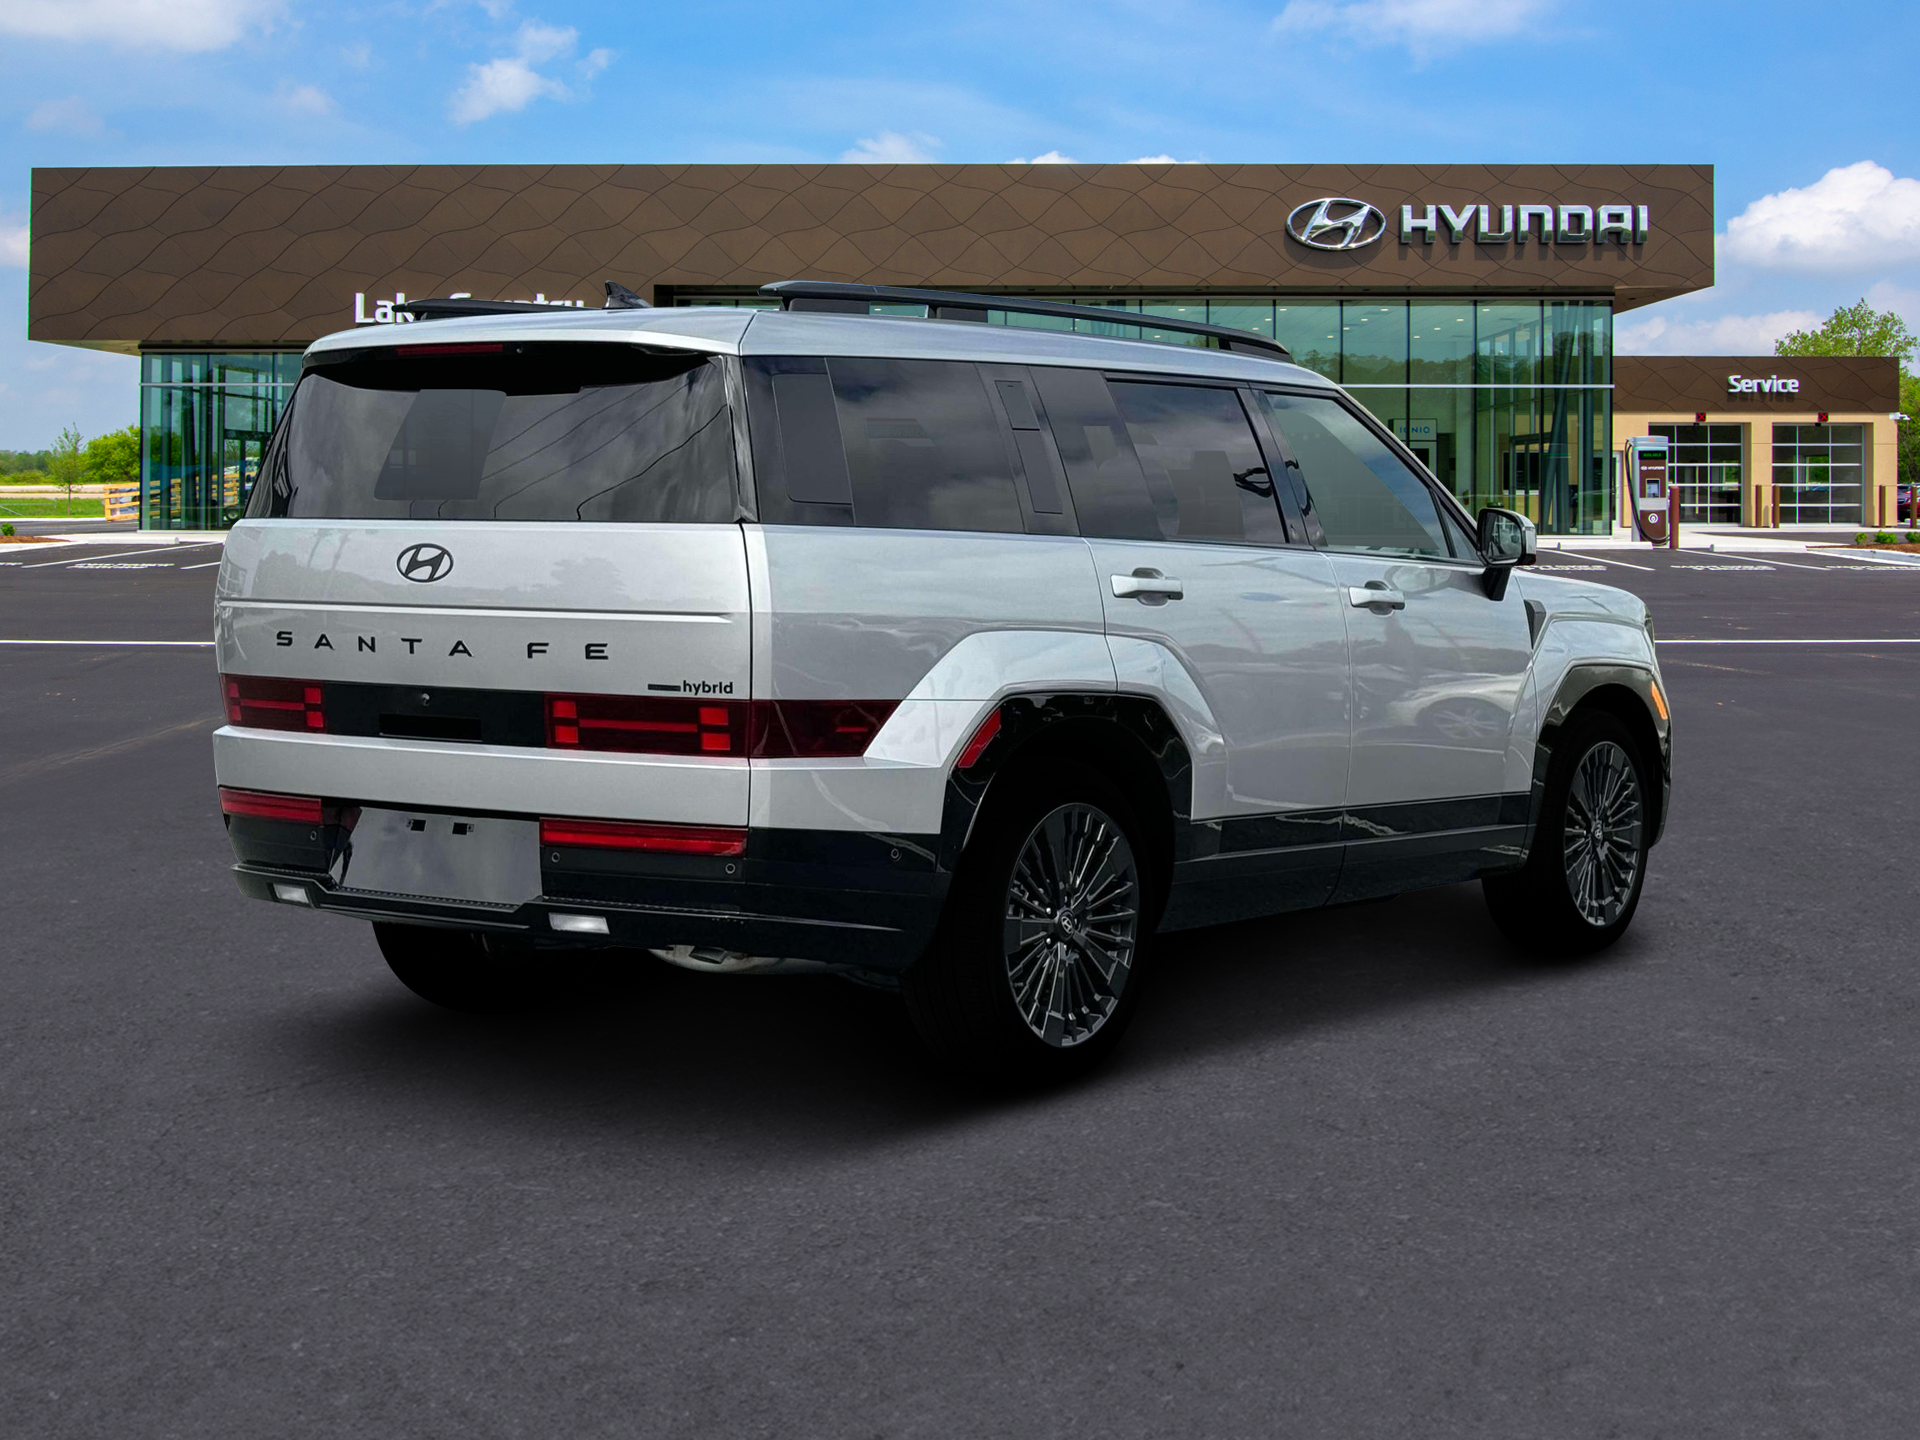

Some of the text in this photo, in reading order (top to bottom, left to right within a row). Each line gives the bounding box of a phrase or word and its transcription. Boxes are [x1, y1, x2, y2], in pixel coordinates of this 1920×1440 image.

[1401, 205, 1648, 243] HYUNDAI
[355, 292, 427, 323] Lak
[1728, 374, 1800, 392] Service
[276, 631, 609, 660] SANTA FE
[683, 680, 733, 696] hybrid
